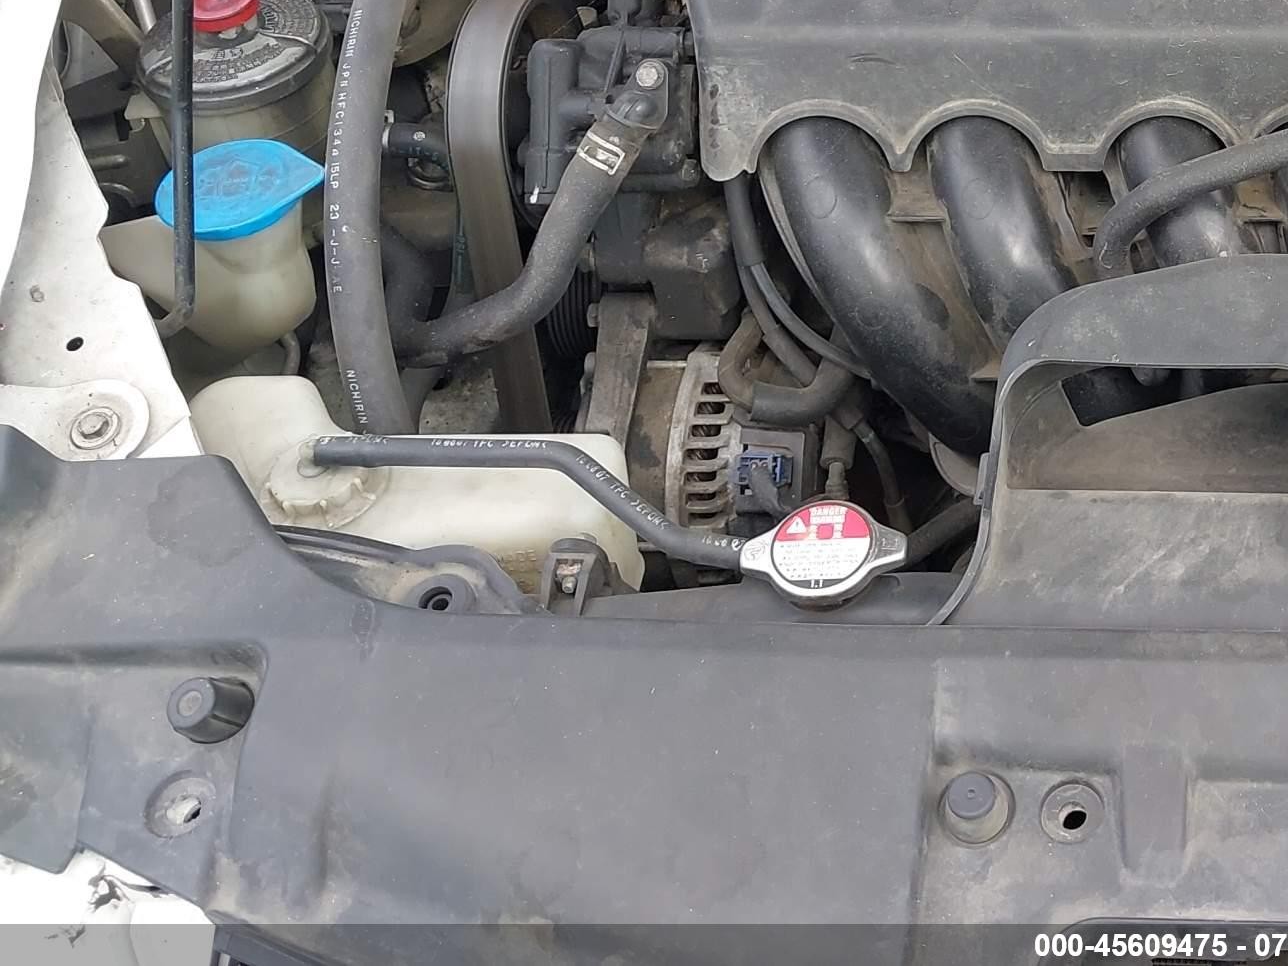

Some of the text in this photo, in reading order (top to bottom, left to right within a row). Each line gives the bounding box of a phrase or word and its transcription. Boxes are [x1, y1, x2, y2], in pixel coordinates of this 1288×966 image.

[344, 9, 363, 59] NICHIRIN
[328, 161, 341, 190] 15LP
[345, 369, 369, 425] NICHIRIN
